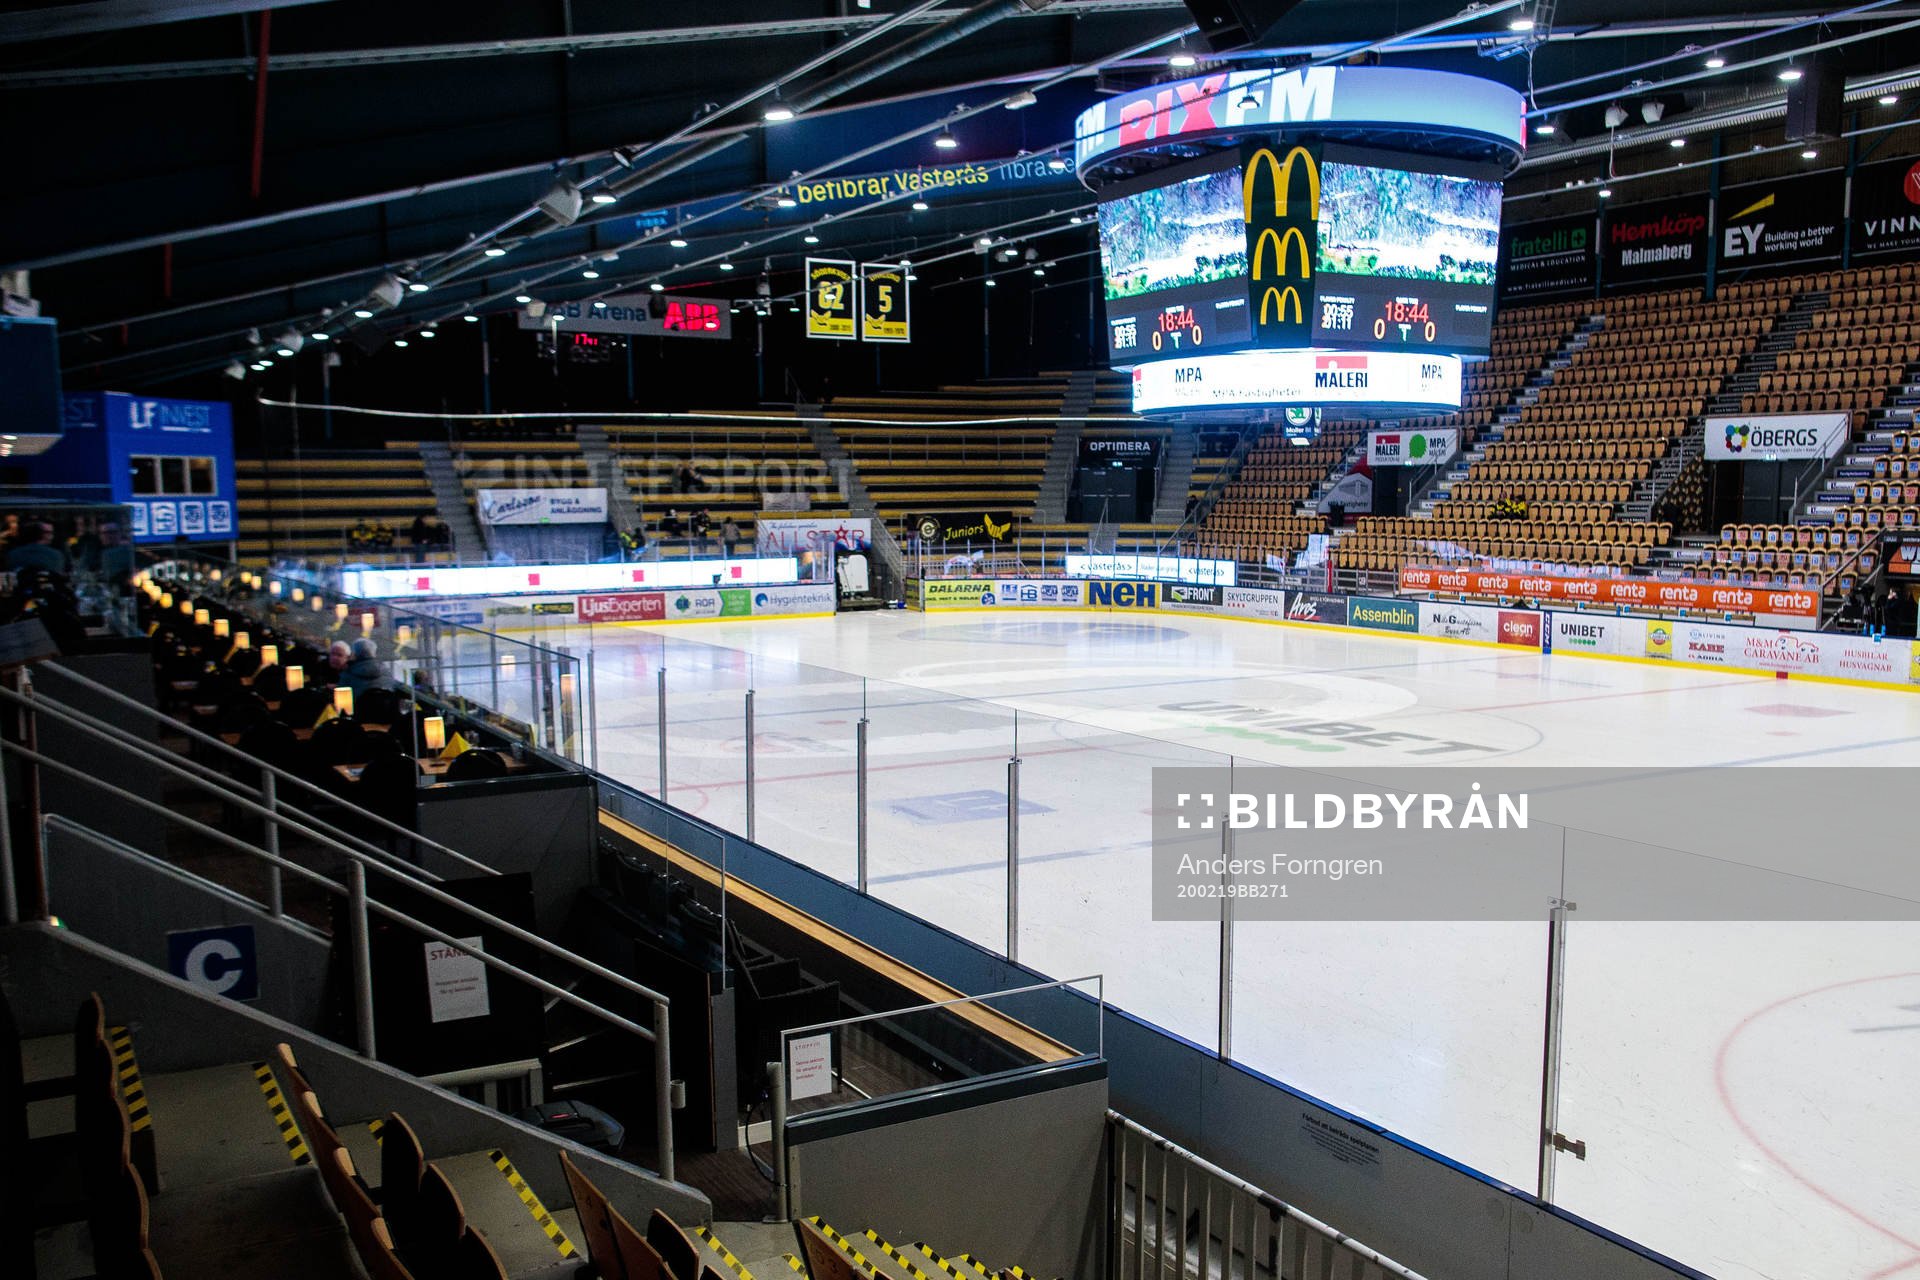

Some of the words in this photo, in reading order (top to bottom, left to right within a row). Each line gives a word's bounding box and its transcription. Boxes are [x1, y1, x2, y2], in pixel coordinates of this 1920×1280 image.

[1612, 213, 1706, 244] Hemköp
[1764, 230, 1798, 243] Building
[1800, 230, 1806, 238] a
[1808, 226, 1834, 236] better
[1512, 229, 1568, 257] fratelli
[1724, 223, 1765, 258] EY
[1764, 240, 1798, 252] working
[1800, 236, 1823, 248] world
[1622, 244, 1692, 266] Malmaberg
[878, 285, 892, 313] 5
[663, 302, 721, 332] ABB
[1158, 308, 1194, 332] 18:44
[1385, 301, 1429, 323] 18:44
[1175, 367, 1202, 383] MPA
[130, 401, 158, 429] LF
[1430, 438, 1446, 448] MPA
[1751, 426, 1818, 446] ÖBERGS
[1090, 442, 1151, 451] OPTIMERA
[944, 525, 984, 541] Juniors
[1403, 571, 1430, 584] renta
[1438, 573, 1466, 586] renta
[1478, 575, 1508, 589] renta
[1520, 577, 1552, 592] renta
[930, 584, 990, 593] DALARNA
[1188, 587, 1215, 601] FRONT
[1564, 580, 1598, 595] renta
[1610, 582, 1647, 598] renta
[1660, 585, 1698, 602] renta
[769, 594, 832, 611] Hygienteknik
[1227, 592, 1279, 604] SKYLTGRUPPEN
[1712, 588, 1753, 606] renta
[1768, 592, 1812, 609] renta
[581, 598, 661, 616] LjusExperten
[1288, 592, 1317, 620] Aros
[1353, 604, 1415, 626] Assemblin
[1504, 620, 1533, 634] clean
[1560, 624, 1605, 638] UNIBET
[1746, 637, 1773, 648] M&M
[1844, 649, 1888, 660] HUSBILAR
[1839, 661, 1892, 672] HUSVAGNAR
[1157, 700, 1506, 756] UNIBET
[186, 939, 243, 995] C
